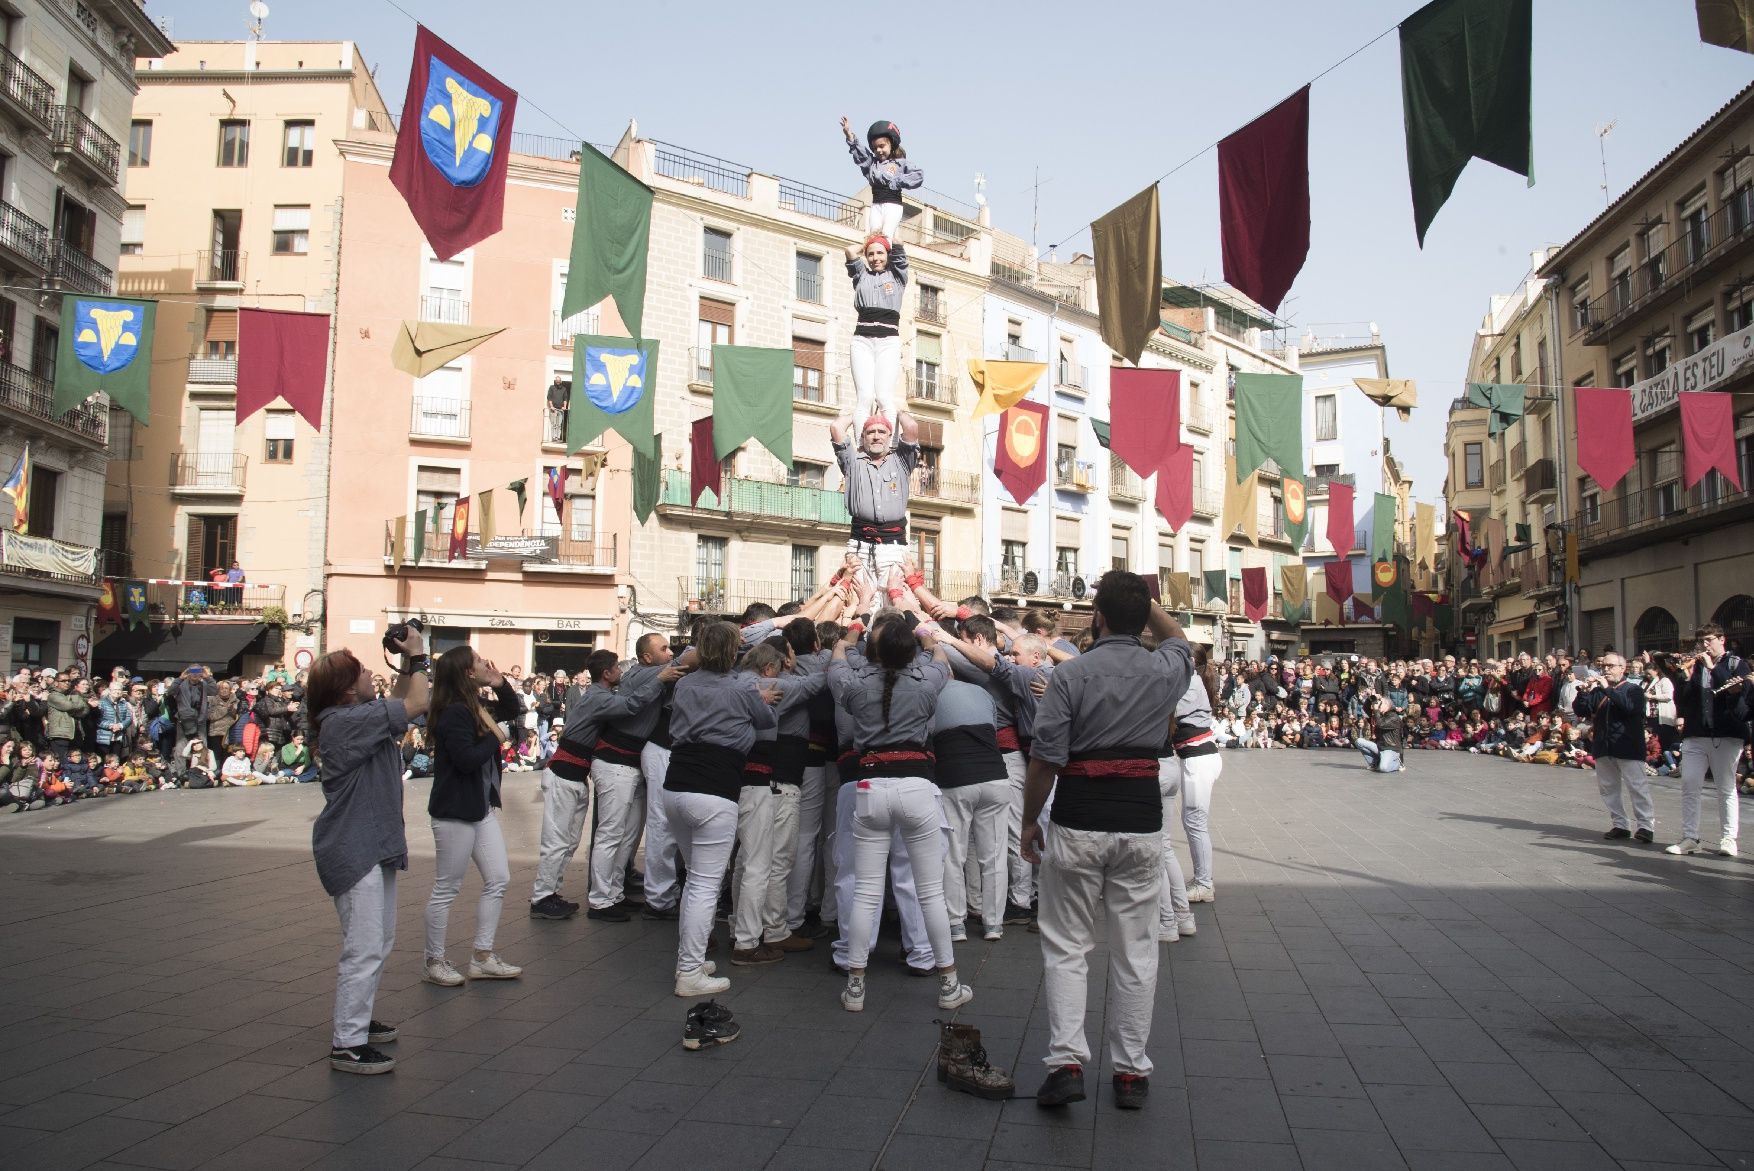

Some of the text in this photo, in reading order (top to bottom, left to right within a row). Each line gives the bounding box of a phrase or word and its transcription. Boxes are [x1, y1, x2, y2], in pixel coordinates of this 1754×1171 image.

[1640, 366, 1680, 414] CATALÀ
[1683, 360, 1698, 392] ÉS
[1702, 347, 1725, 385] TEU
[420, 614, 446, 625] BAR
[557, 619, 581, 629] BAR
